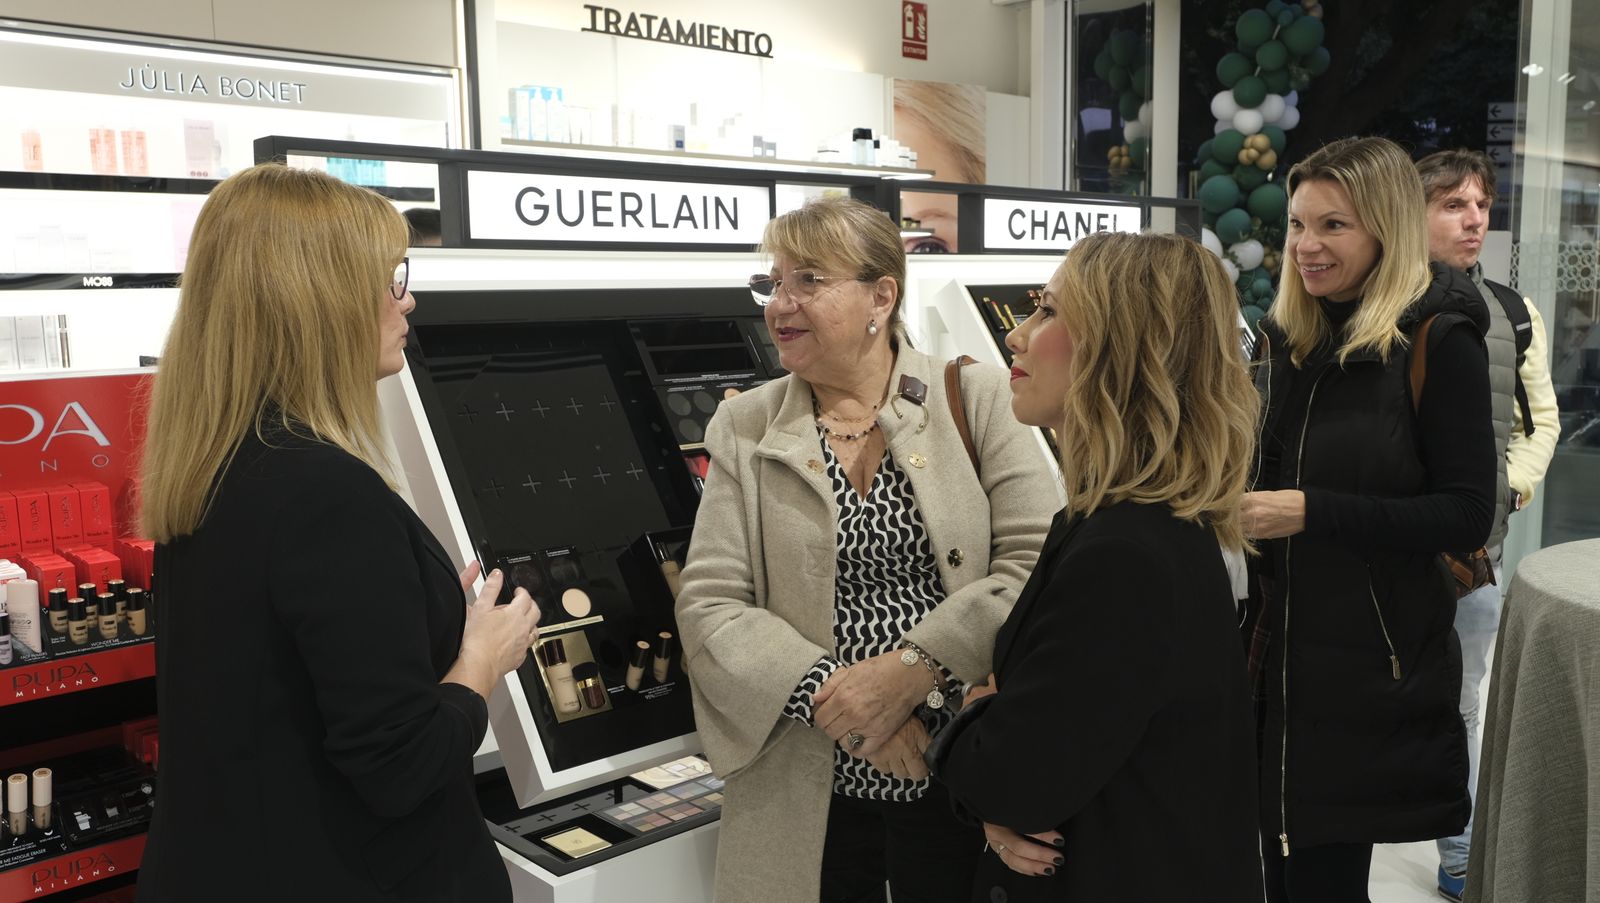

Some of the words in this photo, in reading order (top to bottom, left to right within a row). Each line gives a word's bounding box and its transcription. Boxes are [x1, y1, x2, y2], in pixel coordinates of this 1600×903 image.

[582, 4, 773, 58] TRATAMIENTO
[219, 76, 307, 105] BONET
[515, 185, 740, 232] GUERLAIN
[12, 662, 97, 690] PUPA
[16, 676, 99, 698] MILANO
[31, 852, 114, 886] PUPA
[34, 866, 115, 894] MILANO
